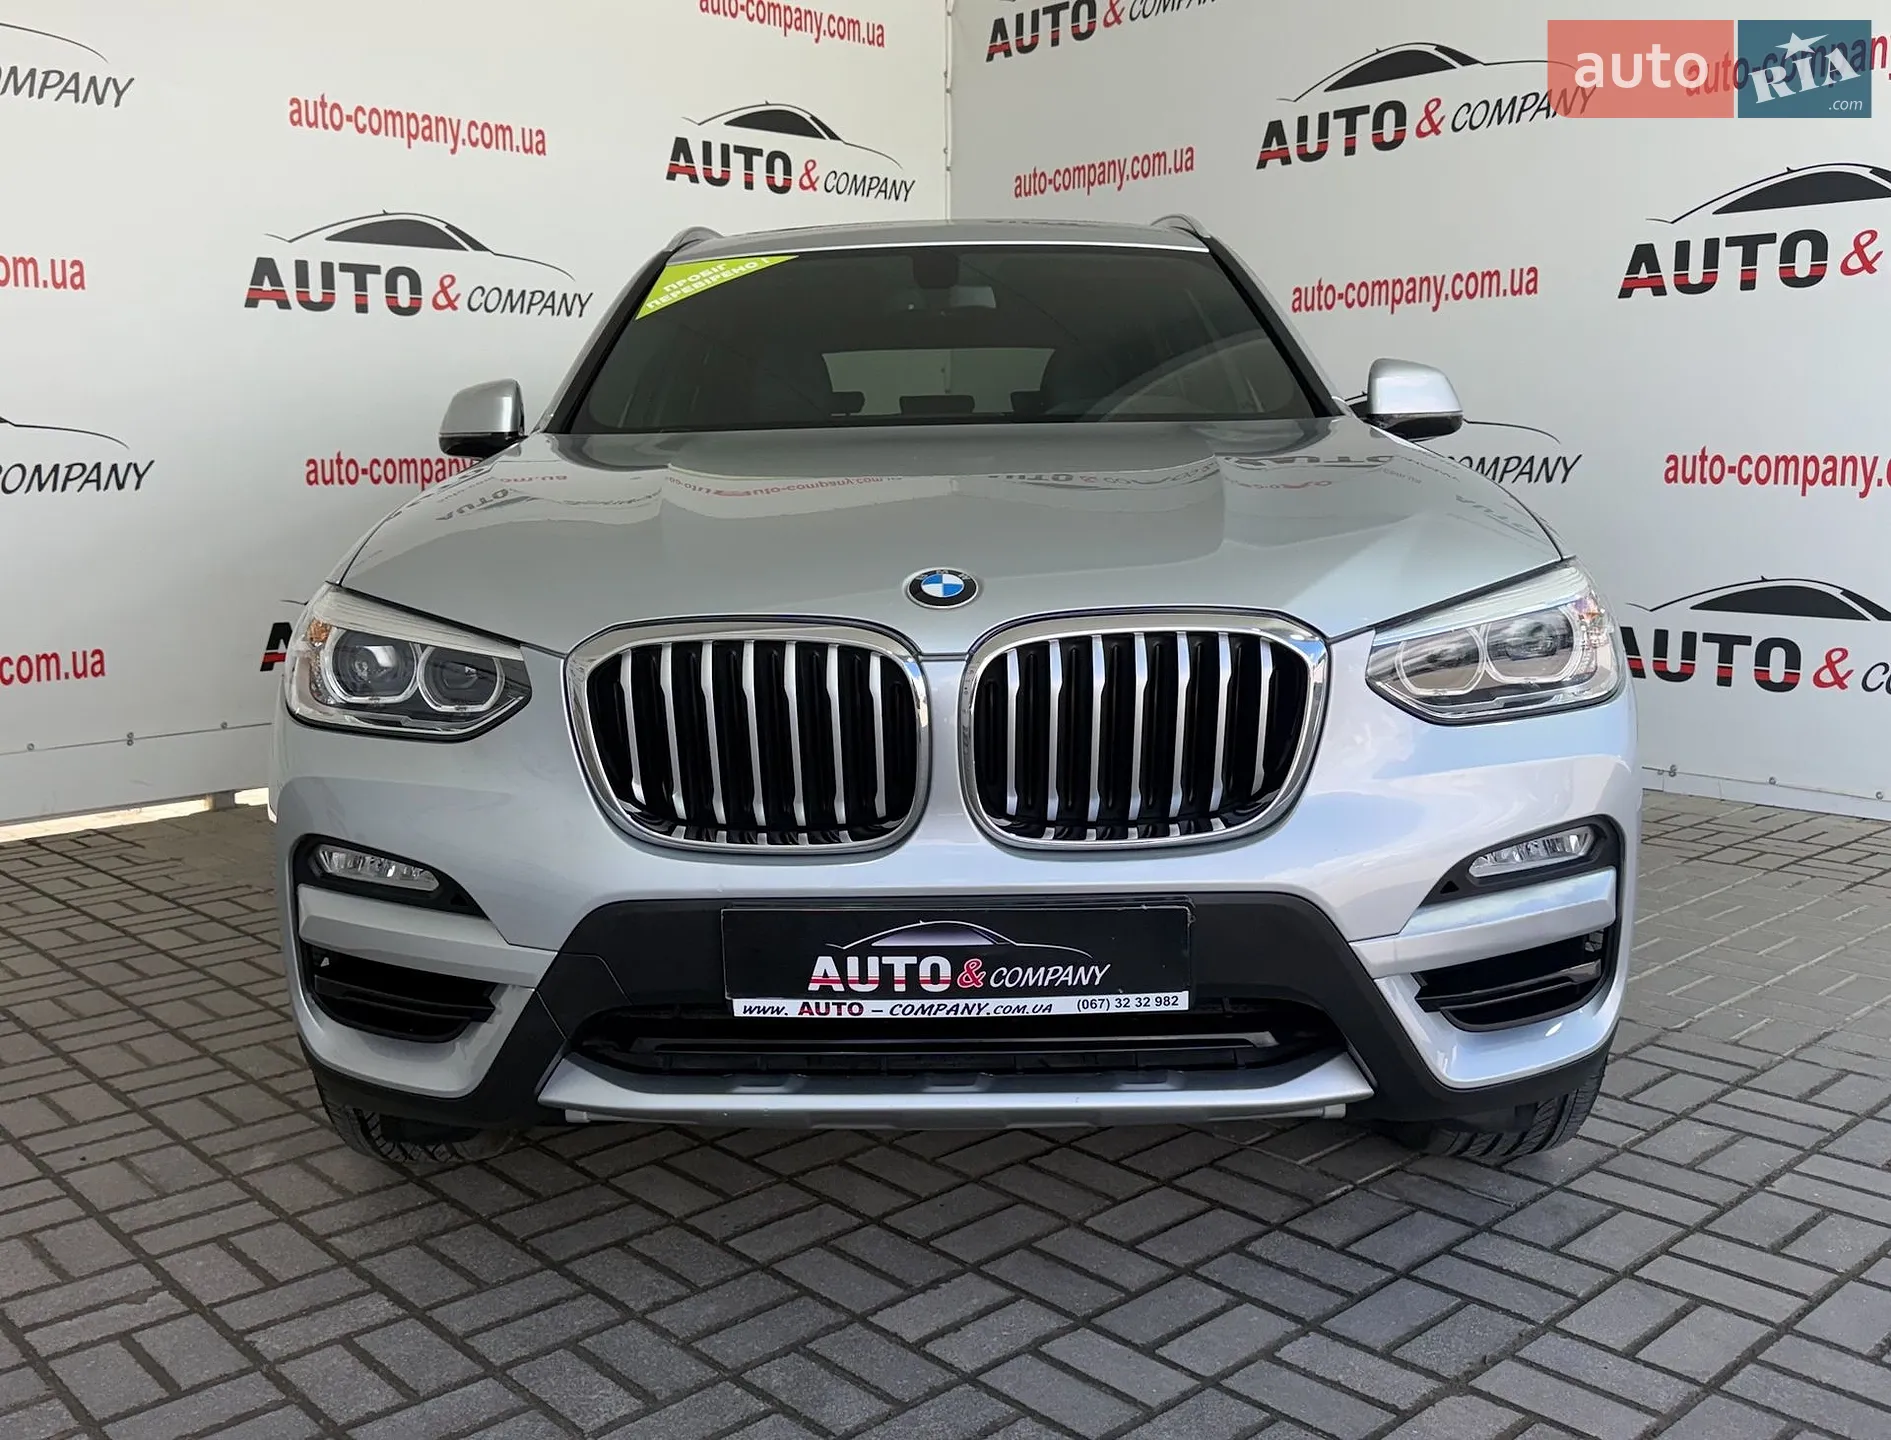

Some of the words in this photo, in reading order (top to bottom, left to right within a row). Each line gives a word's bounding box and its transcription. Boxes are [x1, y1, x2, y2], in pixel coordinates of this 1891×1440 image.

[986, 0, 1098, 62] AUTO
[0, 65, 134, 108] MPANY
[288, 93, 547, 156] auto-company.com.ua
[1256, 100, 1407, 169] AUTO
[1415, 98, 1445, 138] &
[1451, 82, 1597, 134] COMPANY
[666, 137, 792, 194] AUTO
[799, 160, 820, 192] &
[824, 170, 916, 203] COMPANY
[1014, 146, 1195, 198] auto-company.com.ua
[244, 257, 423, 316] AUTO
[432, 274, 461, 312] &
[467, 285, 594, 318] COMPANY
[1618, 229, 1829, 299] AUTO
[1840, 229, 1884, 276] &
[1291, 266, 1539, 314] auto-company.com.ua
[0, 460, 155, 494] OMPANY
[1664, 445, 1891, 498] auto-company.
[0, 649, 106, 686] com.ua
[1812, 647, 1854, 690] &
[808, 956, 952, 993] AUTO
[957, 958, 987, 989] &
[989, 963, 1111, 988] COMPANY
[798, 1001, 864, 1017] AUTO
[1076, 998, 1111, 1012] (067)
[1115, 997, 1131, 1009] 32
[1135, 996, 1151, 1008] 32
[1155, 995, 1179, 1007] 982
